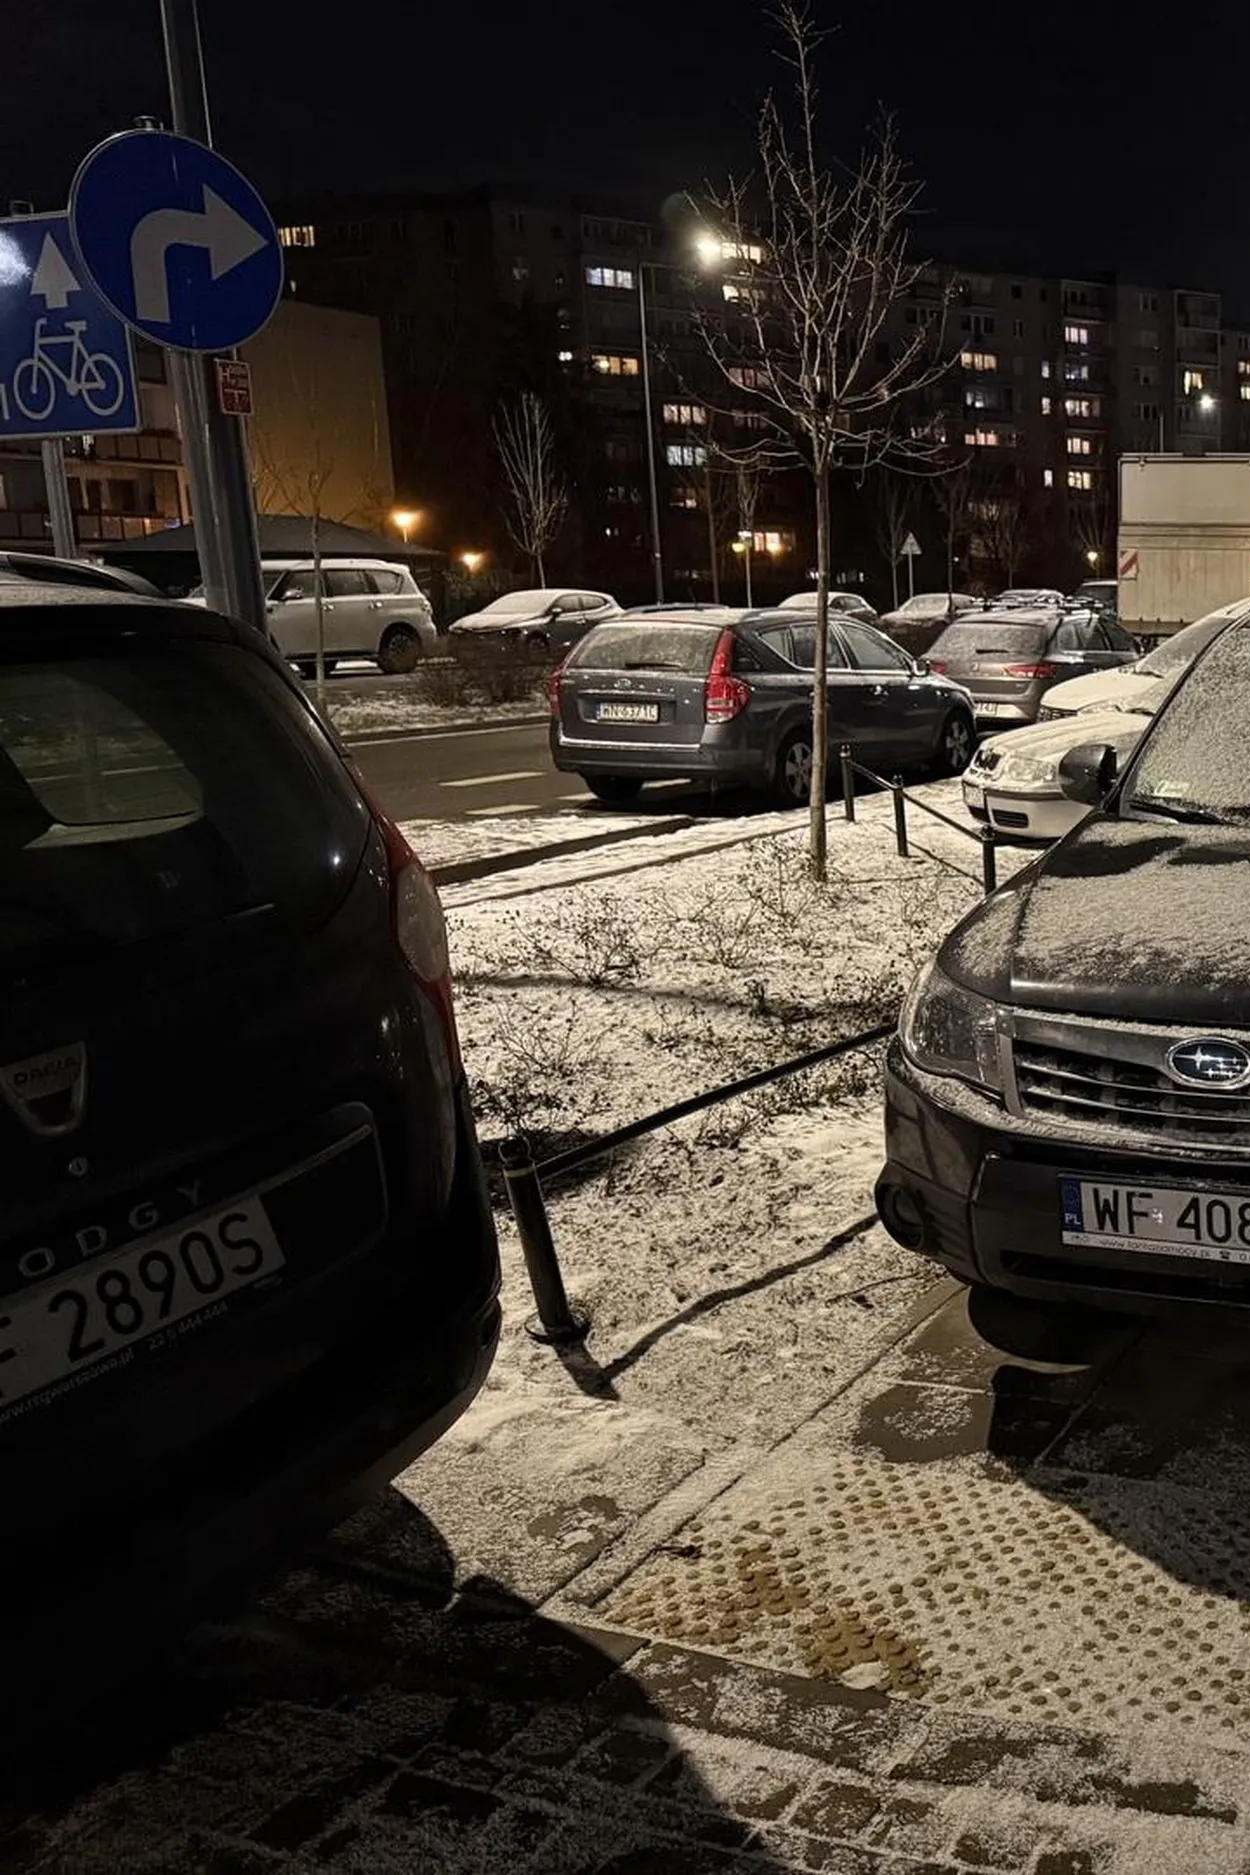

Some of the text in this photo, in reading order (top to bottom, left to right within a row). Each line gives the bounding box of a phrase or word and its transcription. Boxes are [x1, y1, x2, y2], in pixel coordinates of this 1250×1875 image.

[13, 1055, 79, 1086] DACIA
[1064, 1213, 1082, 1225] PL
[1092, 1187, 1153, 1235] WF
[47, 1213, 264, 1364] 2890S
